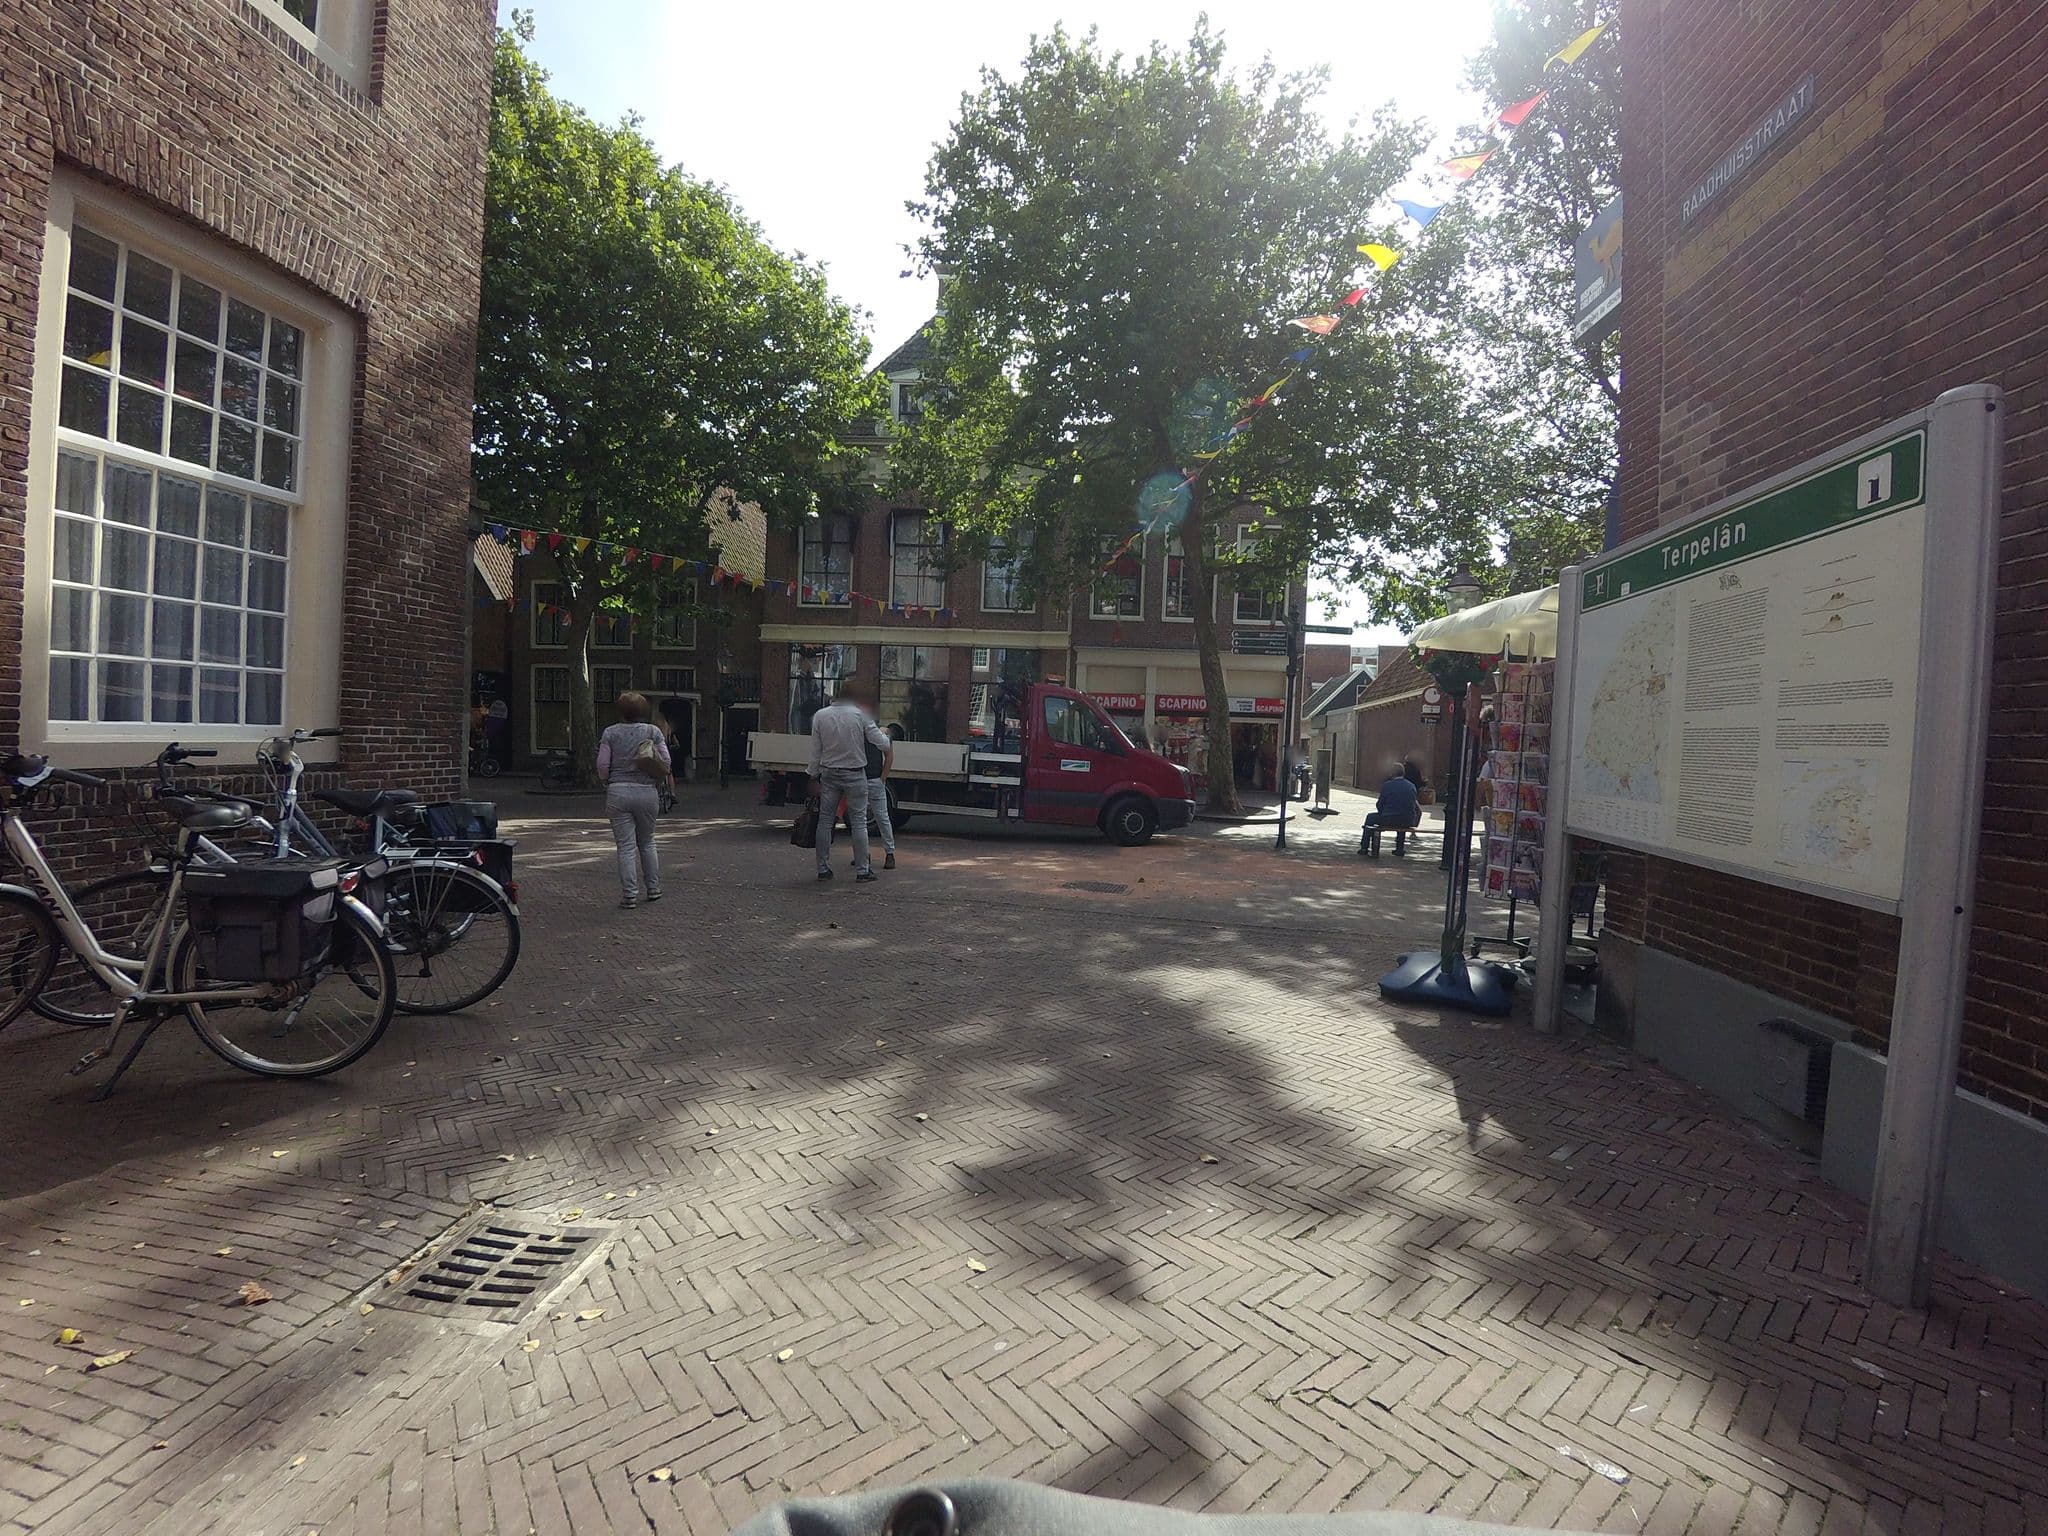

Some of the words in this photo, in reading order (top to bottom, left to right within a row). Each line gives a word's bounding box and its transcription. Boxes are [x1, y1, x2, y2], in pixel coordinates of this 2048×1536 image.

[1682, 84, 1808, 221] RAADHUISSTRAAT
[1661, 522, 1746, 570] Terpelân
[1159, 697, 1207, 709] SCAPINO
[1256, 704, 1284, 712] SCAPINO
